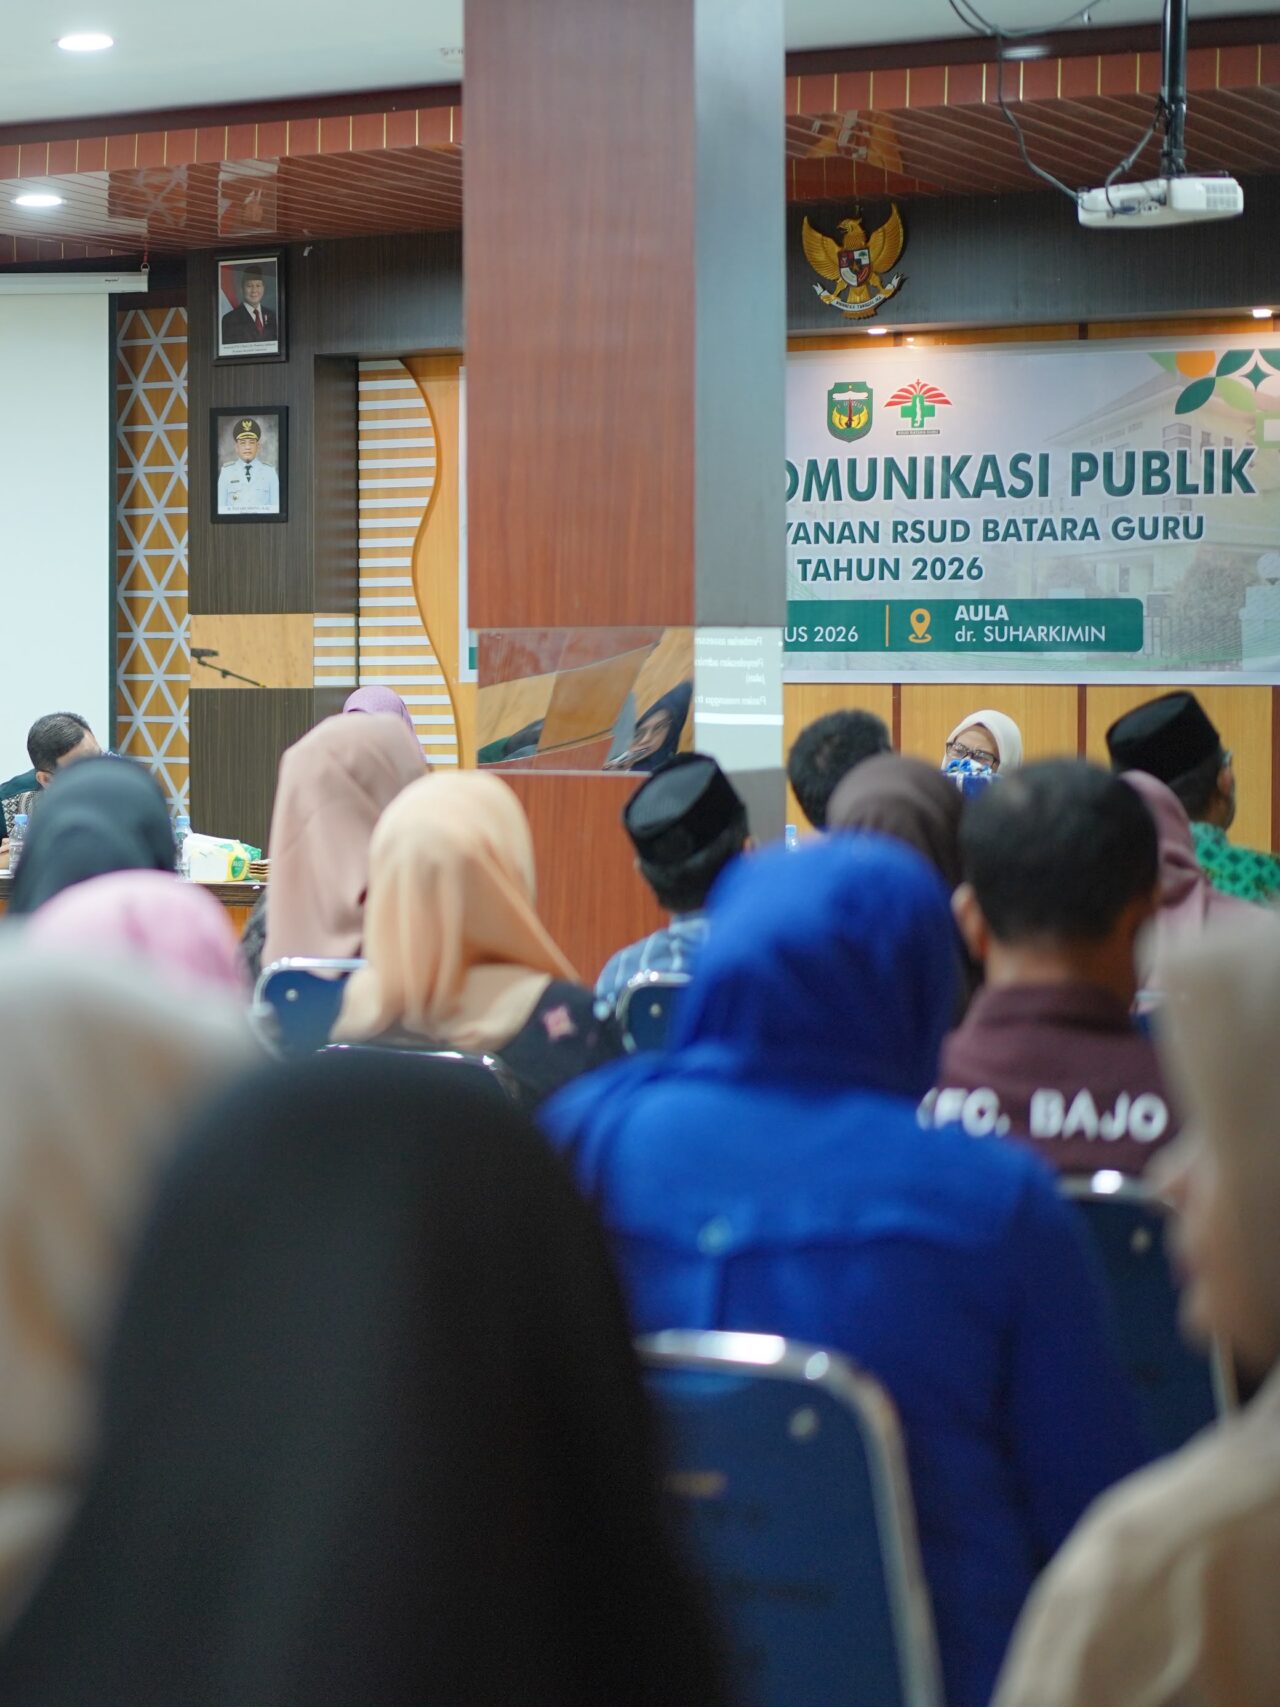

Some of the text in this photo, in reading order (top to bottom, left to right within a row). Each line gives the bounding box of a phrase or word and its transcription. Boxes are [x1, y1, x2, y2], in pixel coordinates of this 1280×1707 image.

[1071, 448, 1256, 498] PUBLIK
[892, 519, 970, 544] RSUD
[982, 517, 1101, 542] BATARA
[1111, 515, 1204, 541] GURU
[797, 556, 984, 582] TAHUN 2026
[955, 604, 1009, 621] AULA
[814, 626, 859, 642] 2026
[955, 625, 1106, 642] dr. SUHARKIMIN
[1029, 1087, 1168, 1143] BAJO
